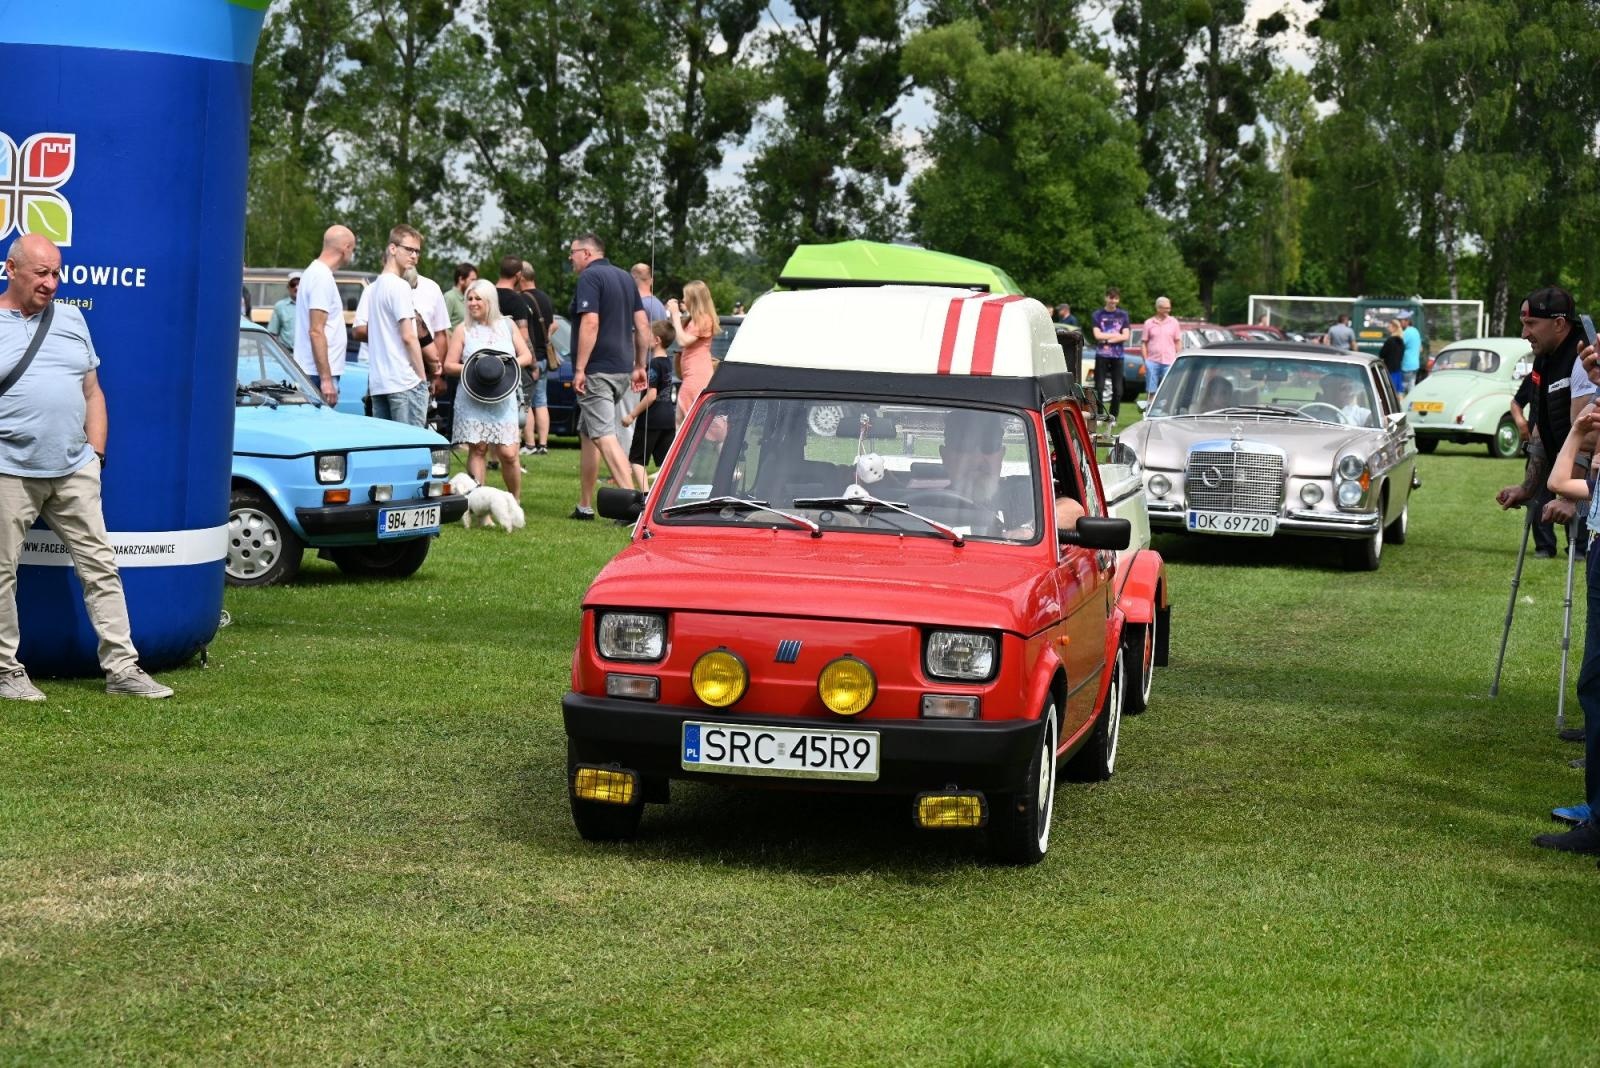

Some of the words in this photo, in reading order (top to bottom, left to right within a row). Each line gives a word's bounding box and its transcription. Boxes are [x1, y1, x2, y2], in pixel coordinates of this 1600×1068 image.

[388, 513, 406, 529] 9B4
[413, 509, 436, 527] 2115
[1198, 514, 1218, 529] OK
[1224, 516, 1269, 532] 69720
[686, 748, 699, 758] PL
[705, 729, 776, 764] SRC
[789, 735, 871, 769] 45R9
